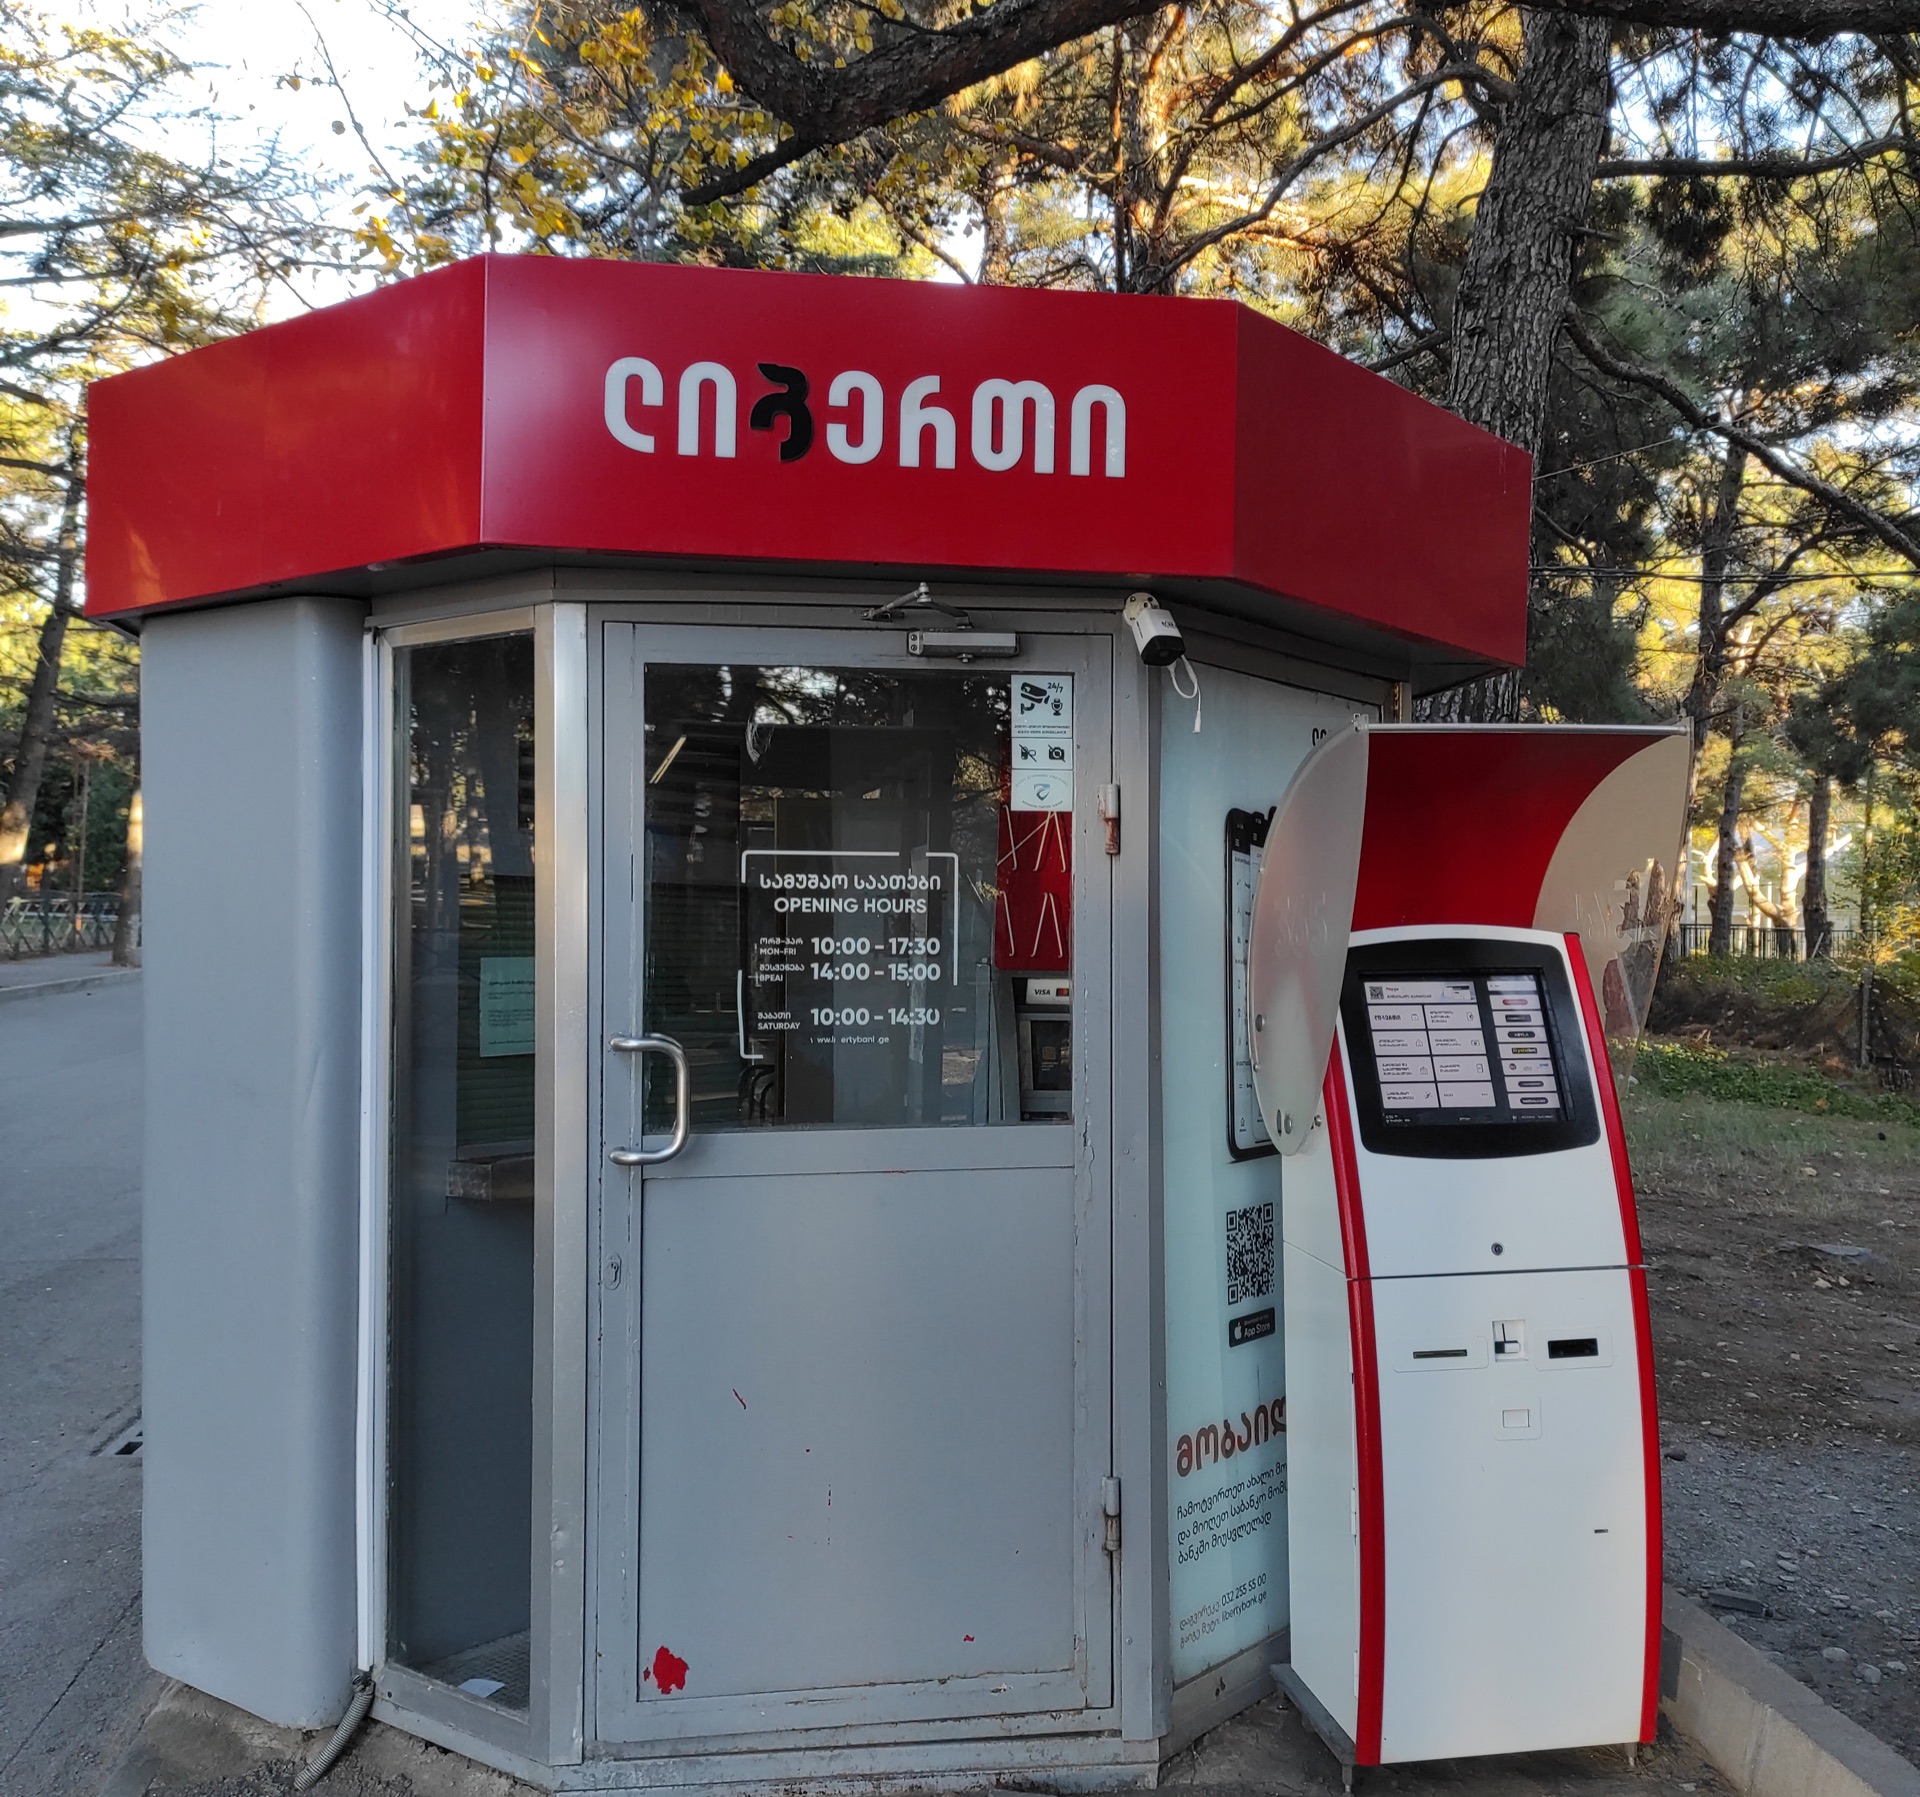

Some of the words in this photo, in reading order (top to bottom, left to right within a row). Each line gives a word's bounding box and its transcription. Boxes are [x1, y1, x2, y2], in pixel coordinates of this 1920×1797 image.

[604, 357, 1127, 478] ლიბერთი
[1047, 682, 1064, 693] 24/7
[759, 873, 848, 890] სამუშაო
[854, 874, 941, 891] საათები
[774, 897, 859, 913] OPENING
[864, 898, 927, 914] HOURS
[759, 947, 797, 956] MON-FRI
[811, 937, 871, 955] 10:00
[888, 937, 941, 955] 17:30
[810, 962, 870, 981] 14:00
[888, 962, 941, 981] 15:00
[757, 1011, 792, 1020] შაბათი
[810, 1007, 870, 1026] 10:00
[888, 1007, 940, 1025] 14:30
[757, 1022, 801, 1030] SATURDAY
[1244, 1327, 1256, 1338] App
[1256, 1322, 1271, 1334] Store
[1177, 1486, 1245, 1520] ჩამოტვირთეთ
[1247, 1469, 1274, 1489] ახალი
[1177, 1529, 1191, 1546] და
[1192, 1510, 1229, 1535] მიიღეთ
[1230, 1493, 1267, 1517] საბანკო
[1178, 1539, 1210, 1564] ბანკში
[1221, 1590, 1235, 1607] 032
[1235, 1582, 1247, 1599] 255
[1248, 1577, 1257, 1592] 55
[1257, 1572, 1267, 1587] 00
[1221, 1590, 1267, 1622] libertybank.ge
